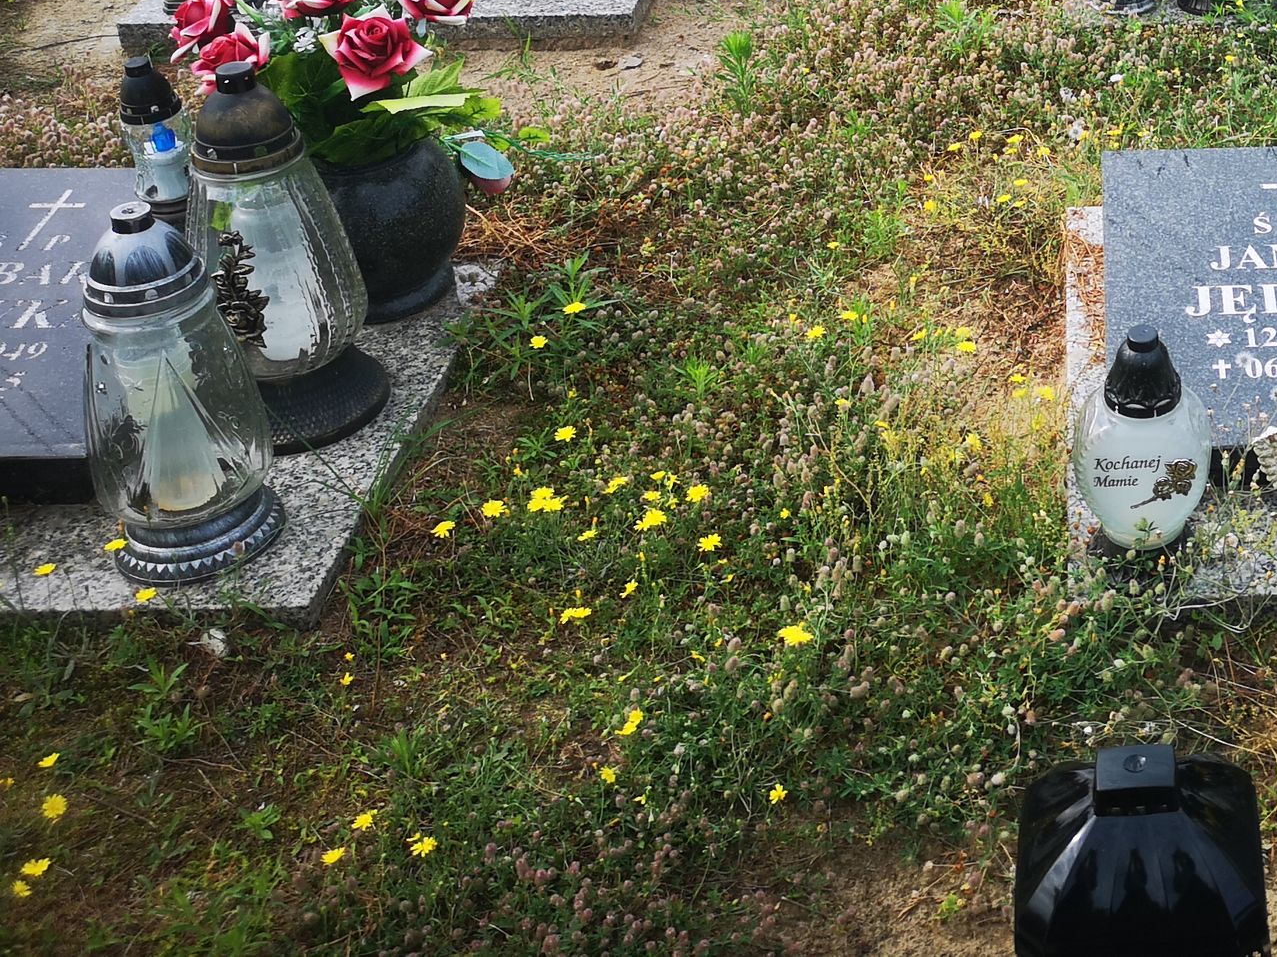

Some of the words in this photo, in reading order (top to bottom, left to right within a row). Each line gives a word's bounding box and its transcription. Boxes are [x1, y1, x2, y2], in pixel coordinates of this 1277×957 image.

[1253, 212, 1272, 234] Ś
[1093, 455, 1162, 473] Kochanej
[1093, 475, 1139, 487] Mamie
